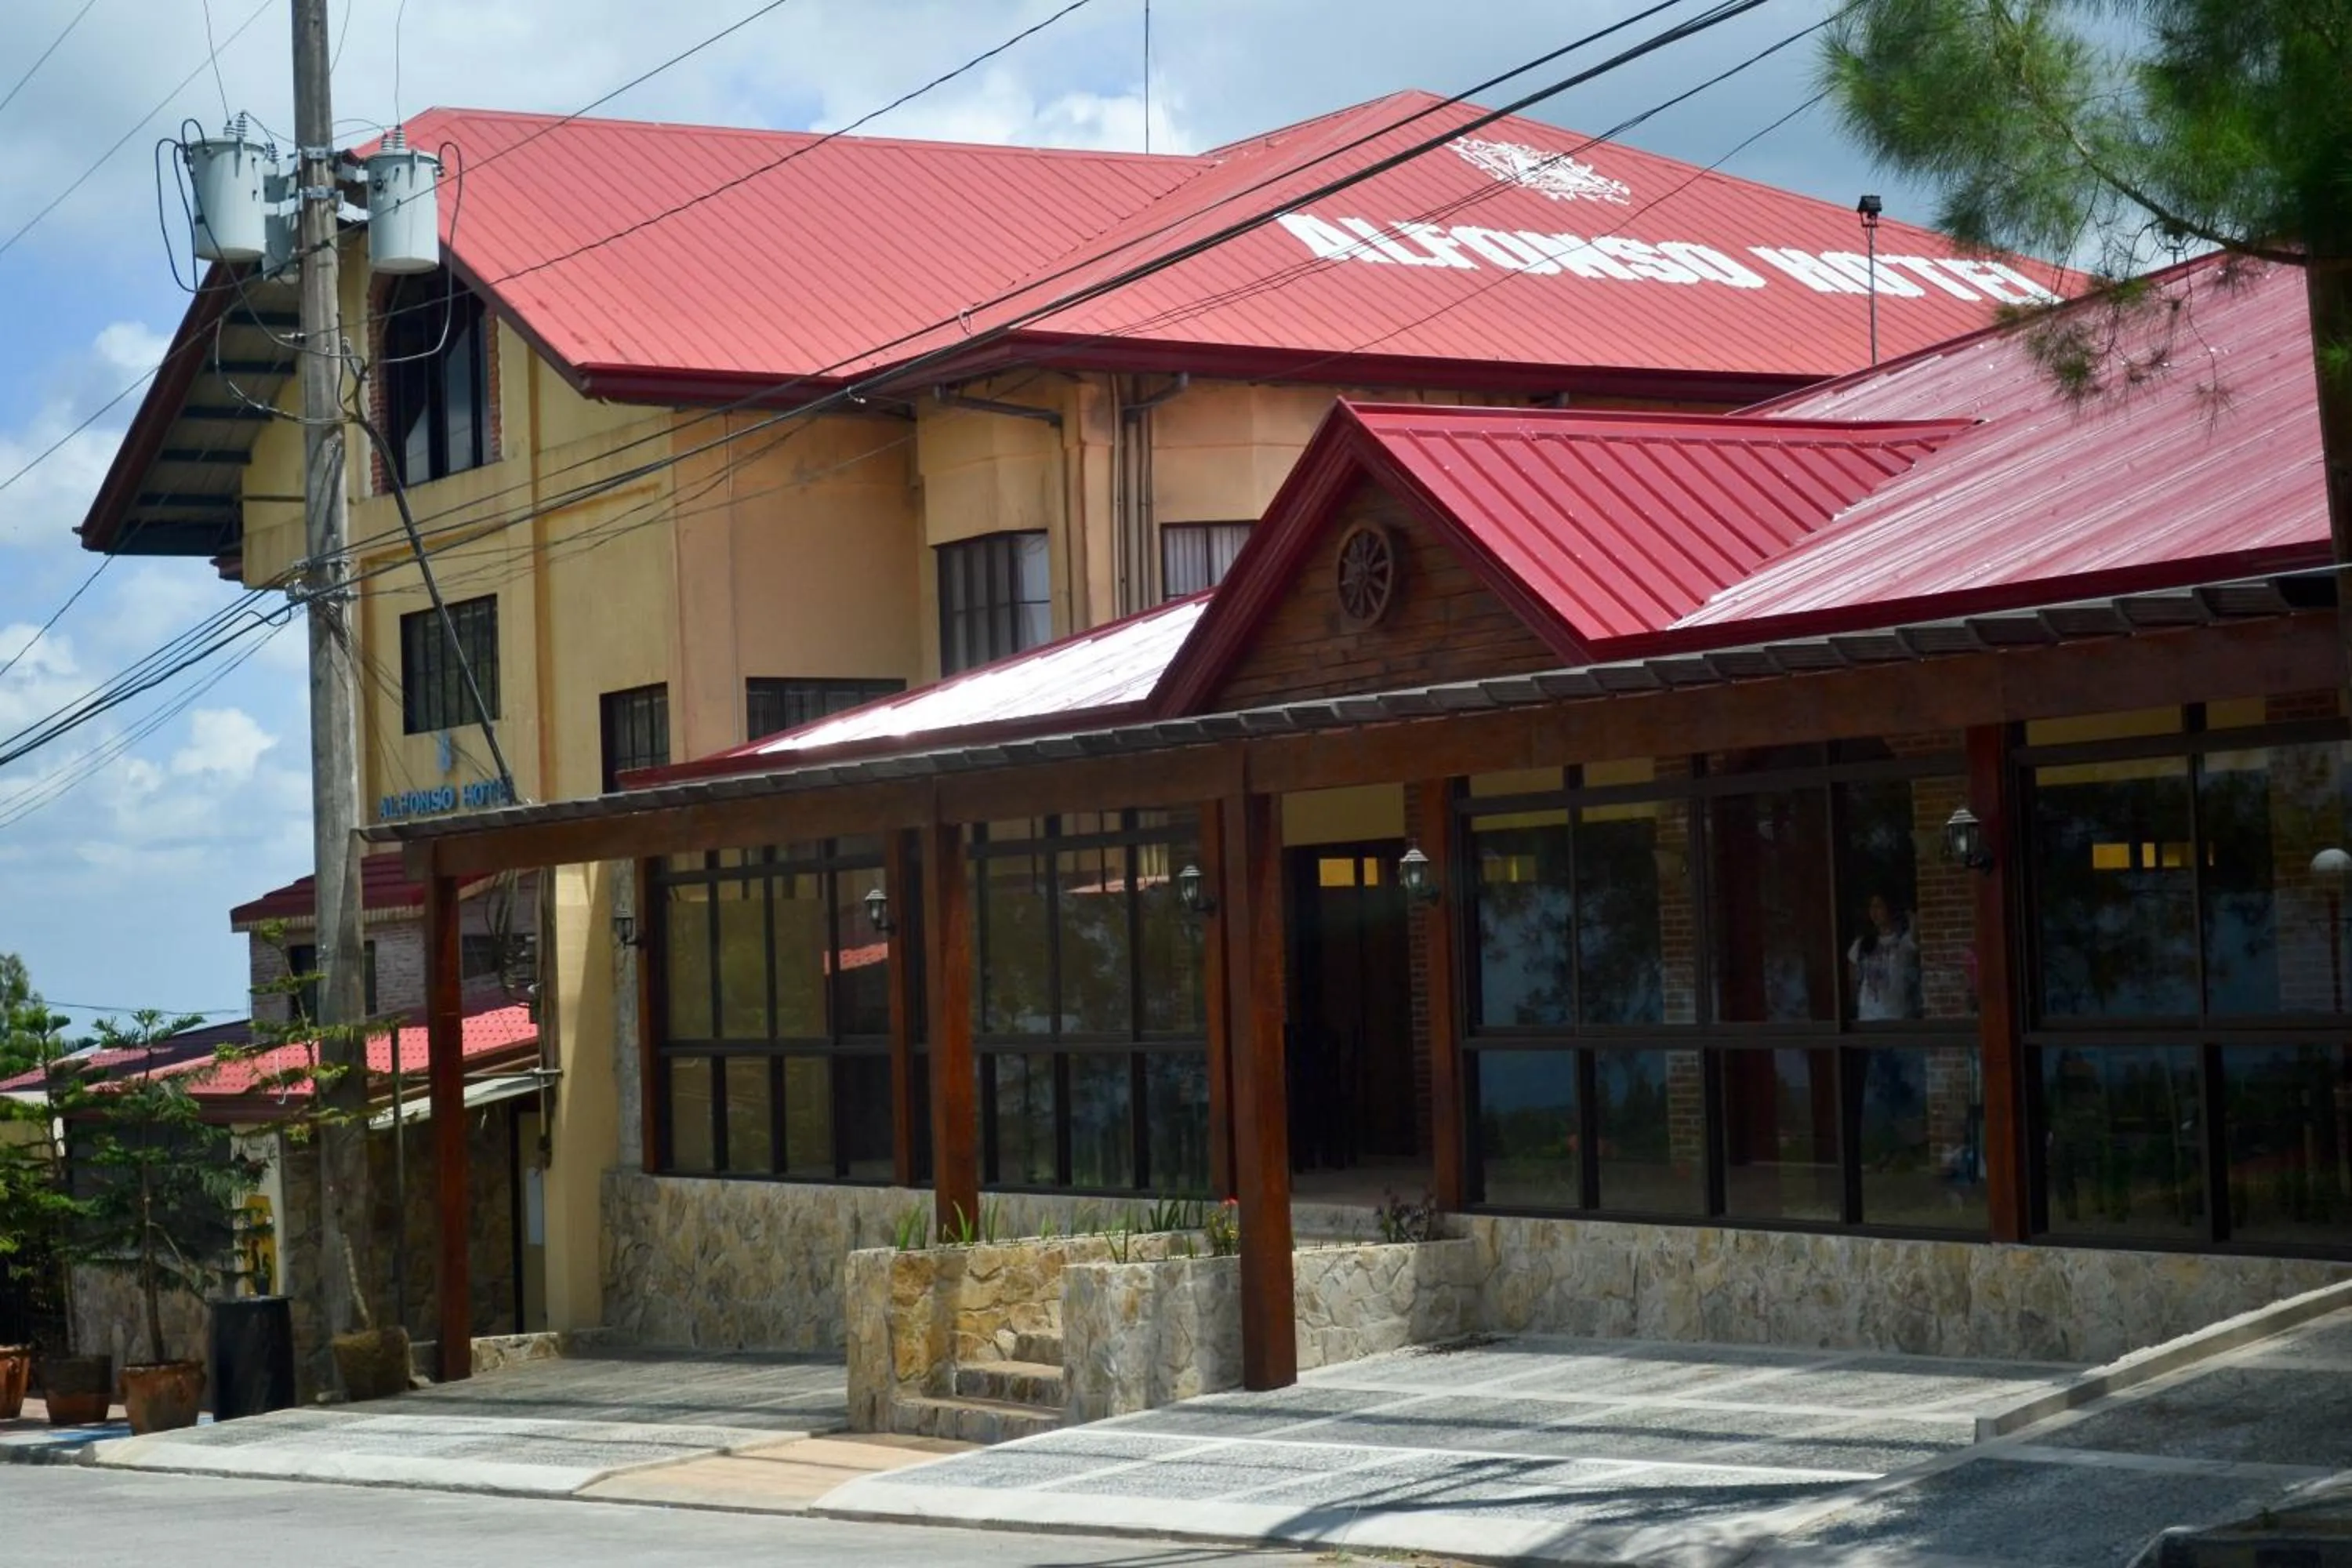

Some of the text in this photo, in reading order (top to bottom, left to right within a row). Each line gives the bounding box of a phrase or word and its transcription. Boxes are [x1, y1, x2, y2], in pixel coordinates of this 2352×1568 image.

[1274, 212, 2068, 307] ALFONSO HOTEL
[379, 779, 511, 819] ALFONSO HOTE
